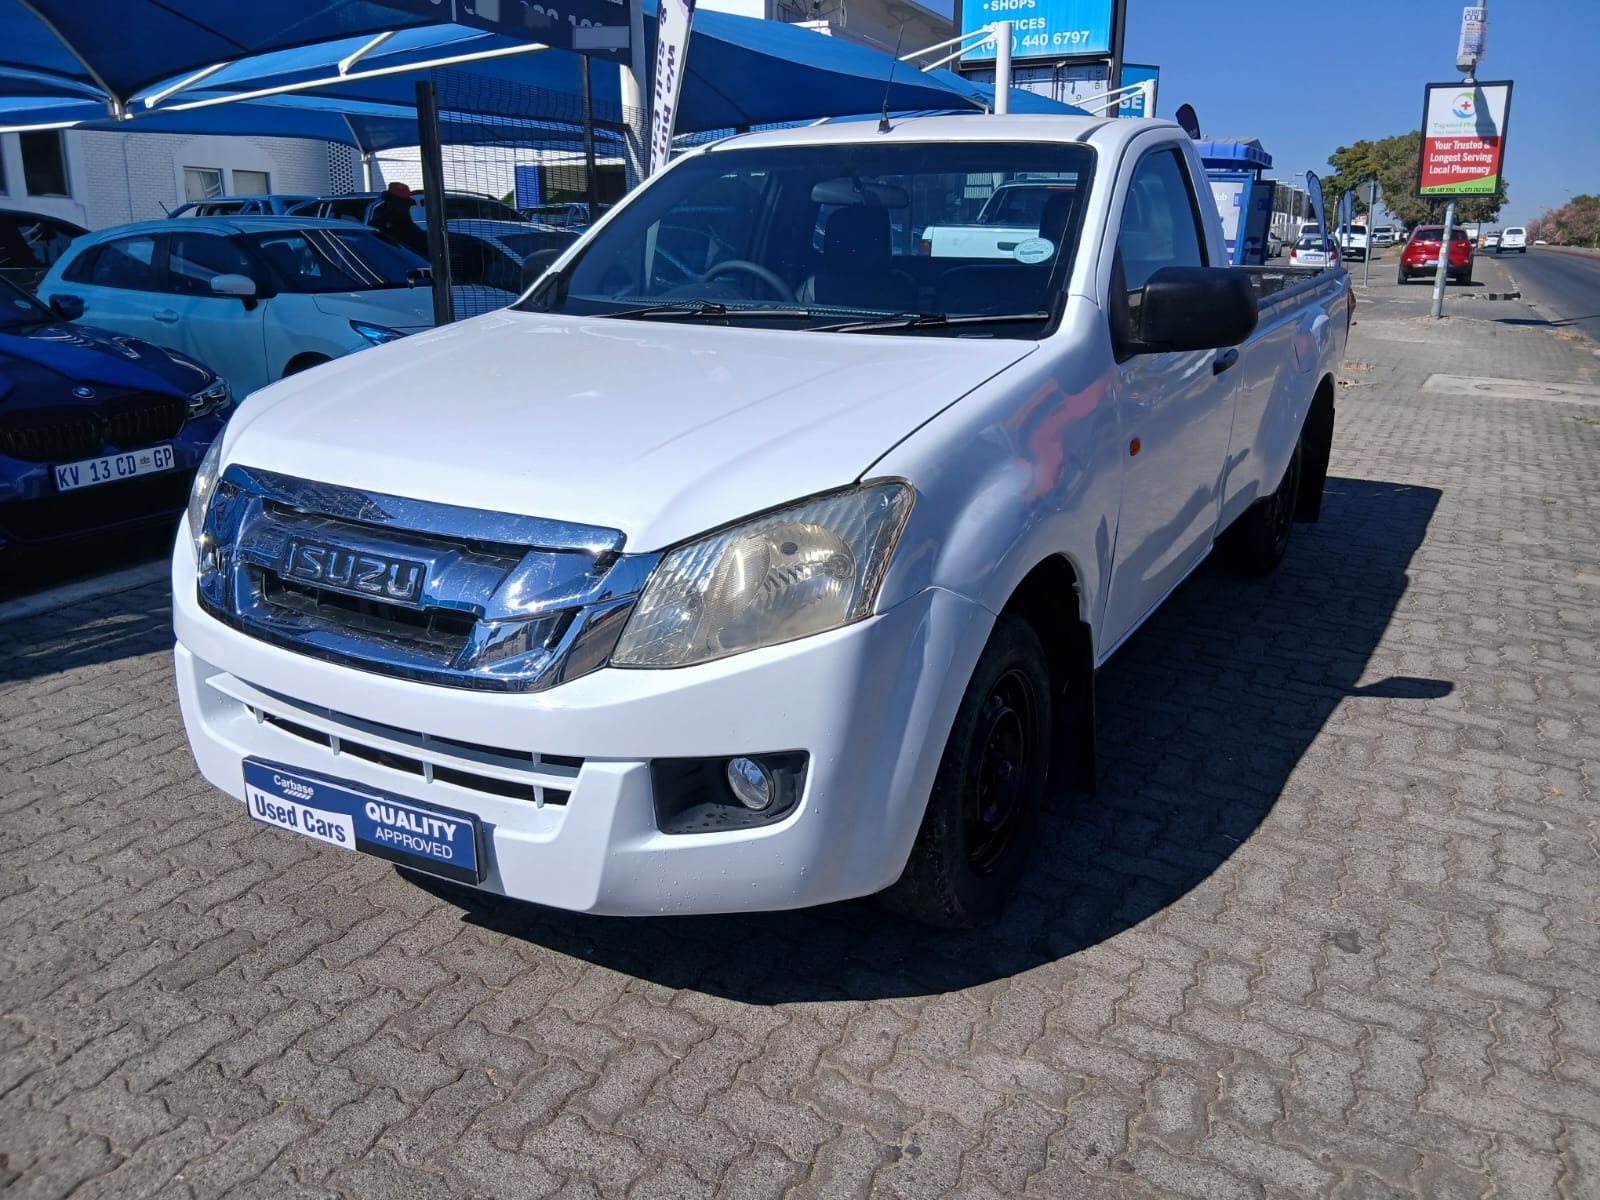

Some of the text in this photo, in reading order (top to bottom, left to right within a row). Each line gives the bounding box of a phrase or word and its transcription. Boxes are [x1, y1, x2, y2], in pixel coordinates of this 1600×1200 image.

[991, 0, 1037, 11] SHOPS
[1022, 34, 1049, 48] 440
[1053, 30, 1090, 45] 6797
[656, 37, 665, 101] Sell
[667, 45, 676, 94] We
[1430, 152, 1492, 164] Longest Serving
[1434, 140, 1452, 150] Your
[1453, 140, 1483, 150] Trusted
[1429, 165, 1491, 175] Local Pharmacy
[57, 447, 172, 488] KV 13 CD GP
[286, 543, 419, 599] ISUZU
[273, 774, 314, 796] Carbase
[254, 793, 346, 843] Used Cars
[365, 802, 456, 842] QUALITY
[375, 826, 453, 859] APPROVED
